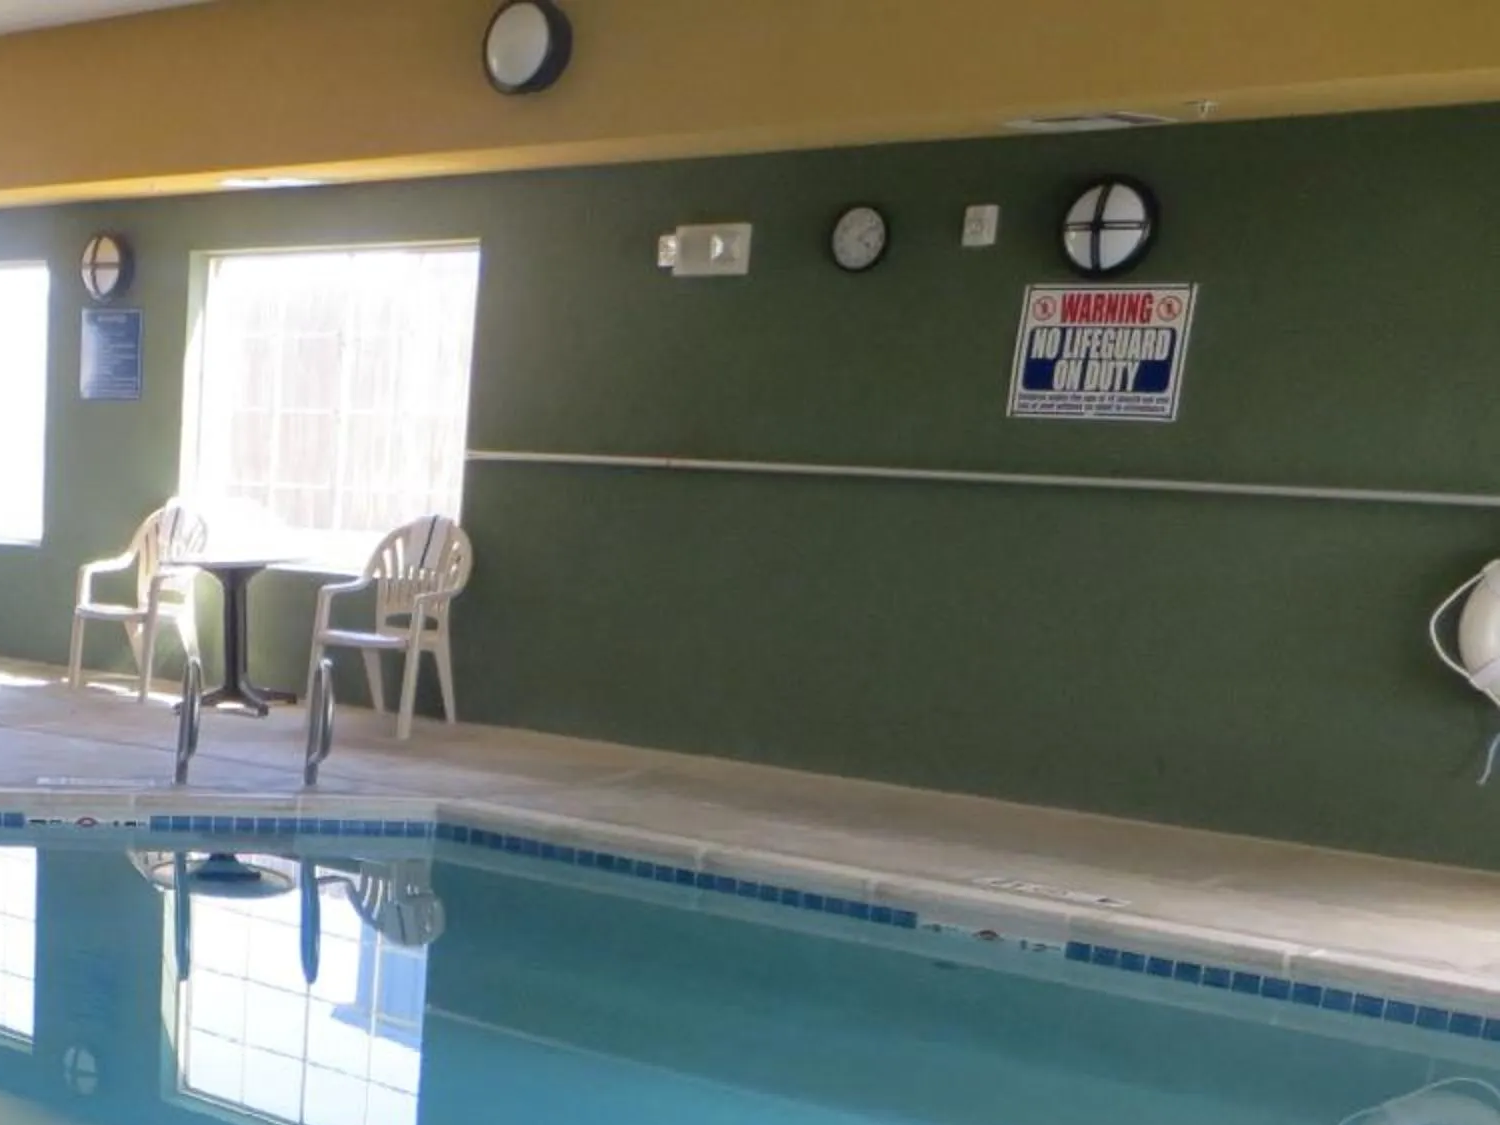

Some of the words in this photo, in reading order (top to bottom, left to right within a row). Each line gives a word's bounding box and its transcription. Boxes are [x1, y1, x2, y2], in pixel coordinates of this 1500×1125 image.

[1060, 292, 1154, 325] WARNING
[1031, 327, 1061, 359] NO
[1062, 327, 1170, 360] LIFEGUARD
[1052, 359, 1083, 391] ON
[1084, 359, 1140, 392] DUTY
